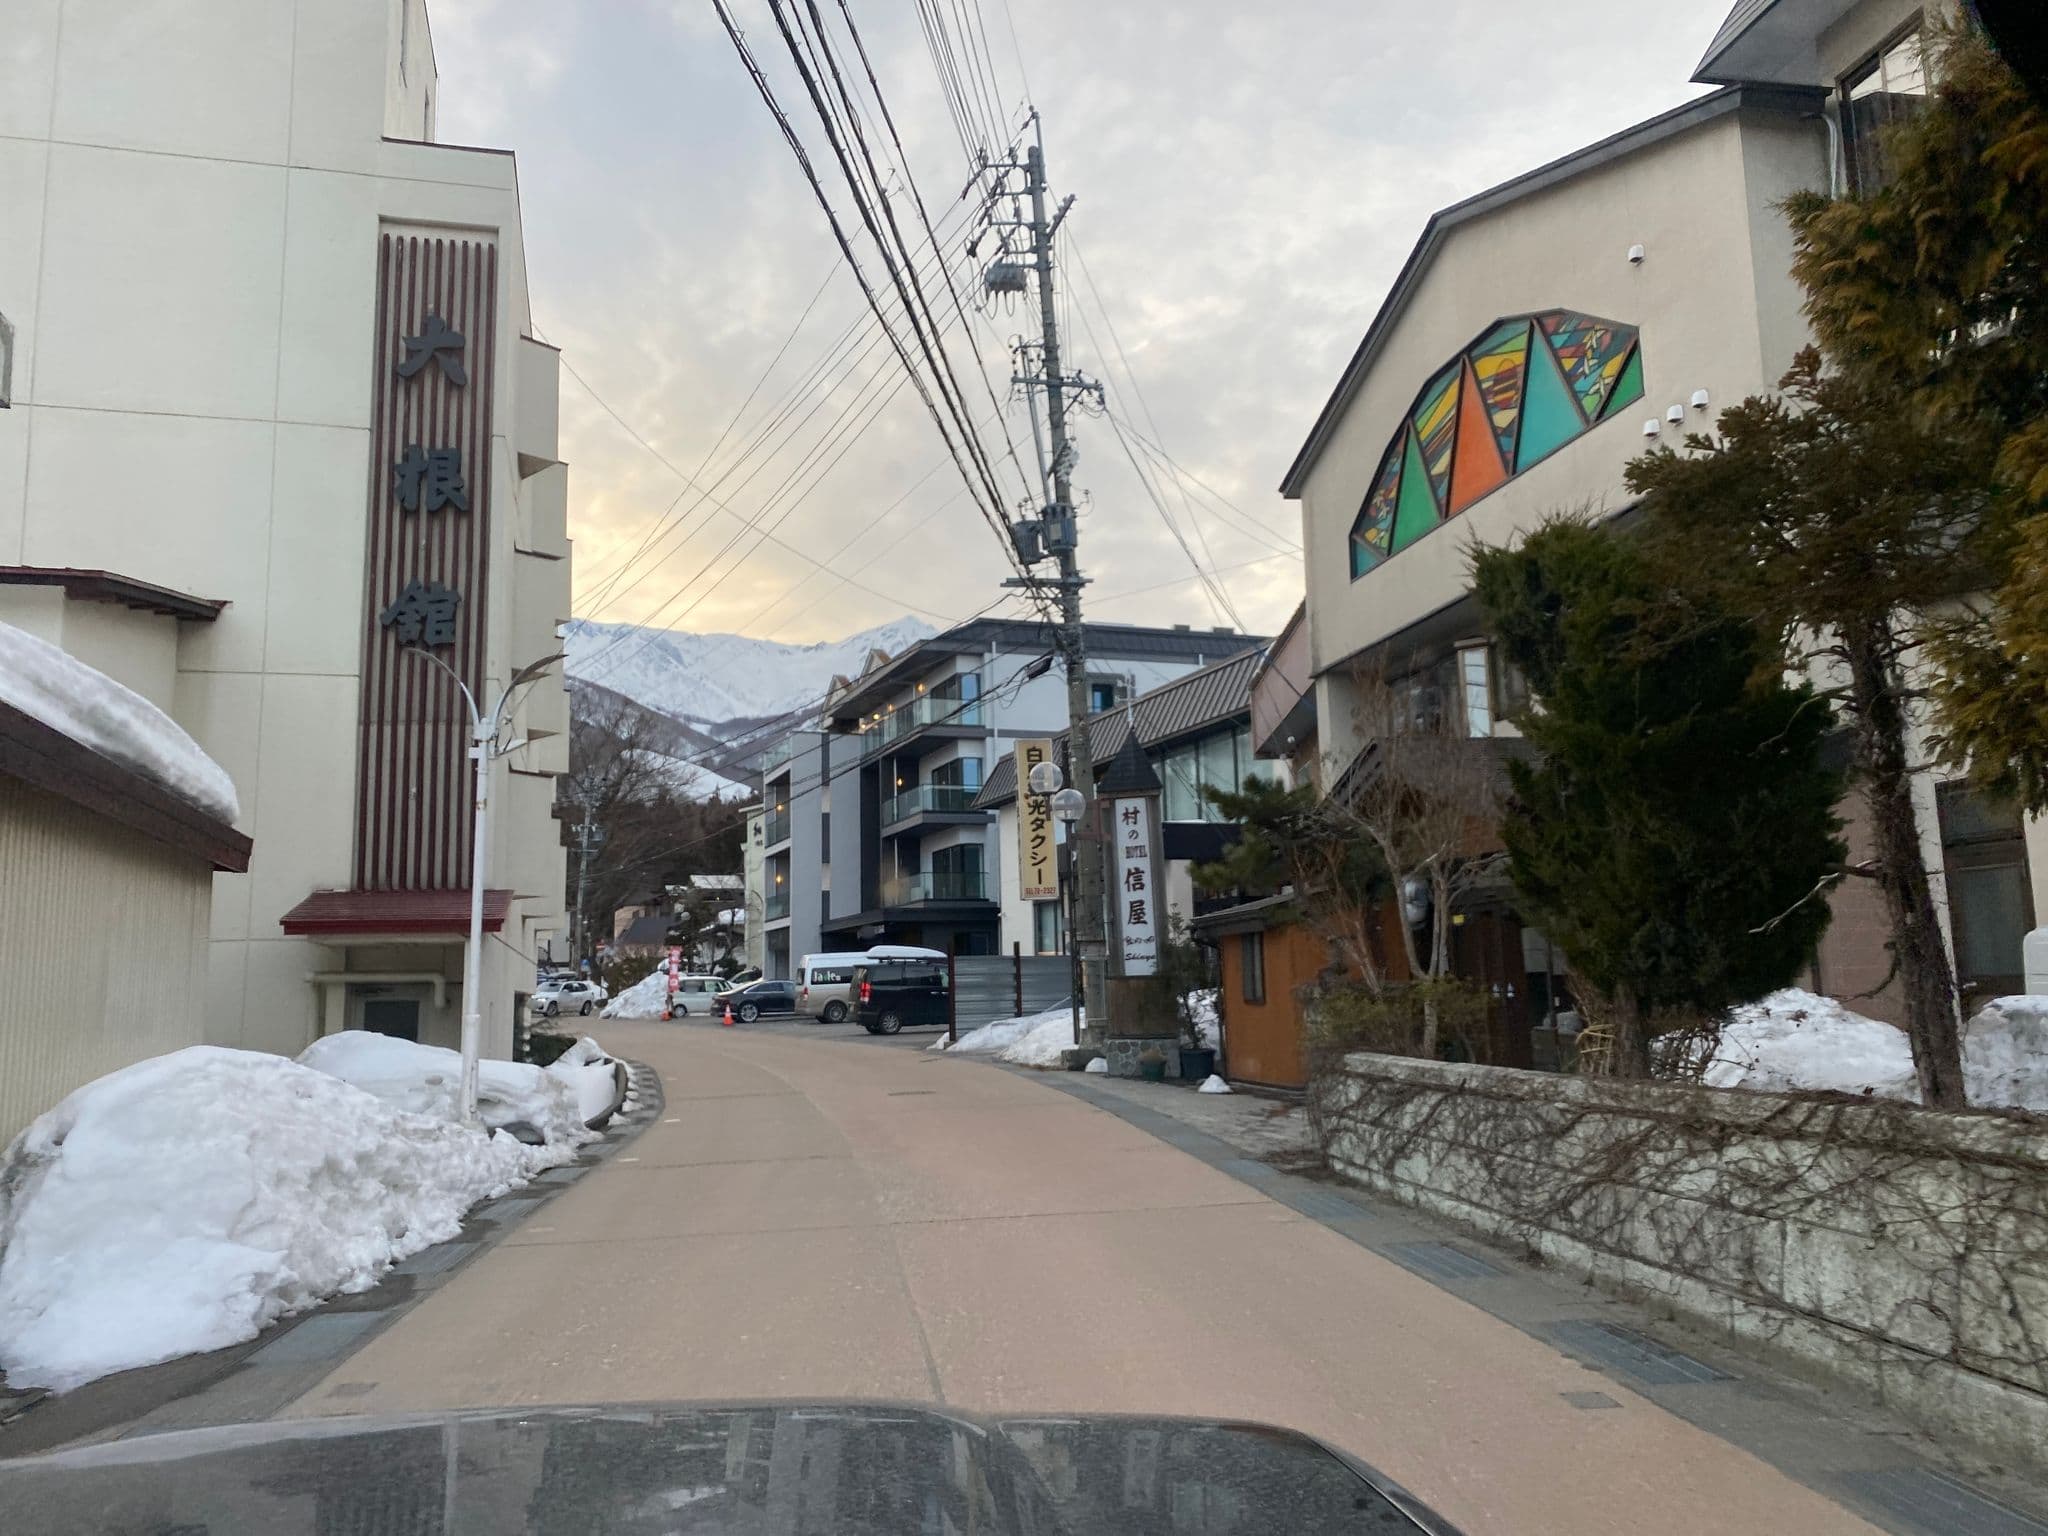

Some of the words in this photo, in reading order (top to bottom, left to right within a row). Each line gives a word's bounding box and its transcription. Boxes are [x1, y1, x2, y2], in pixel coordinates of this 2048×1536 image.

[1024, 745, 1049, 885] 白光タクシー
